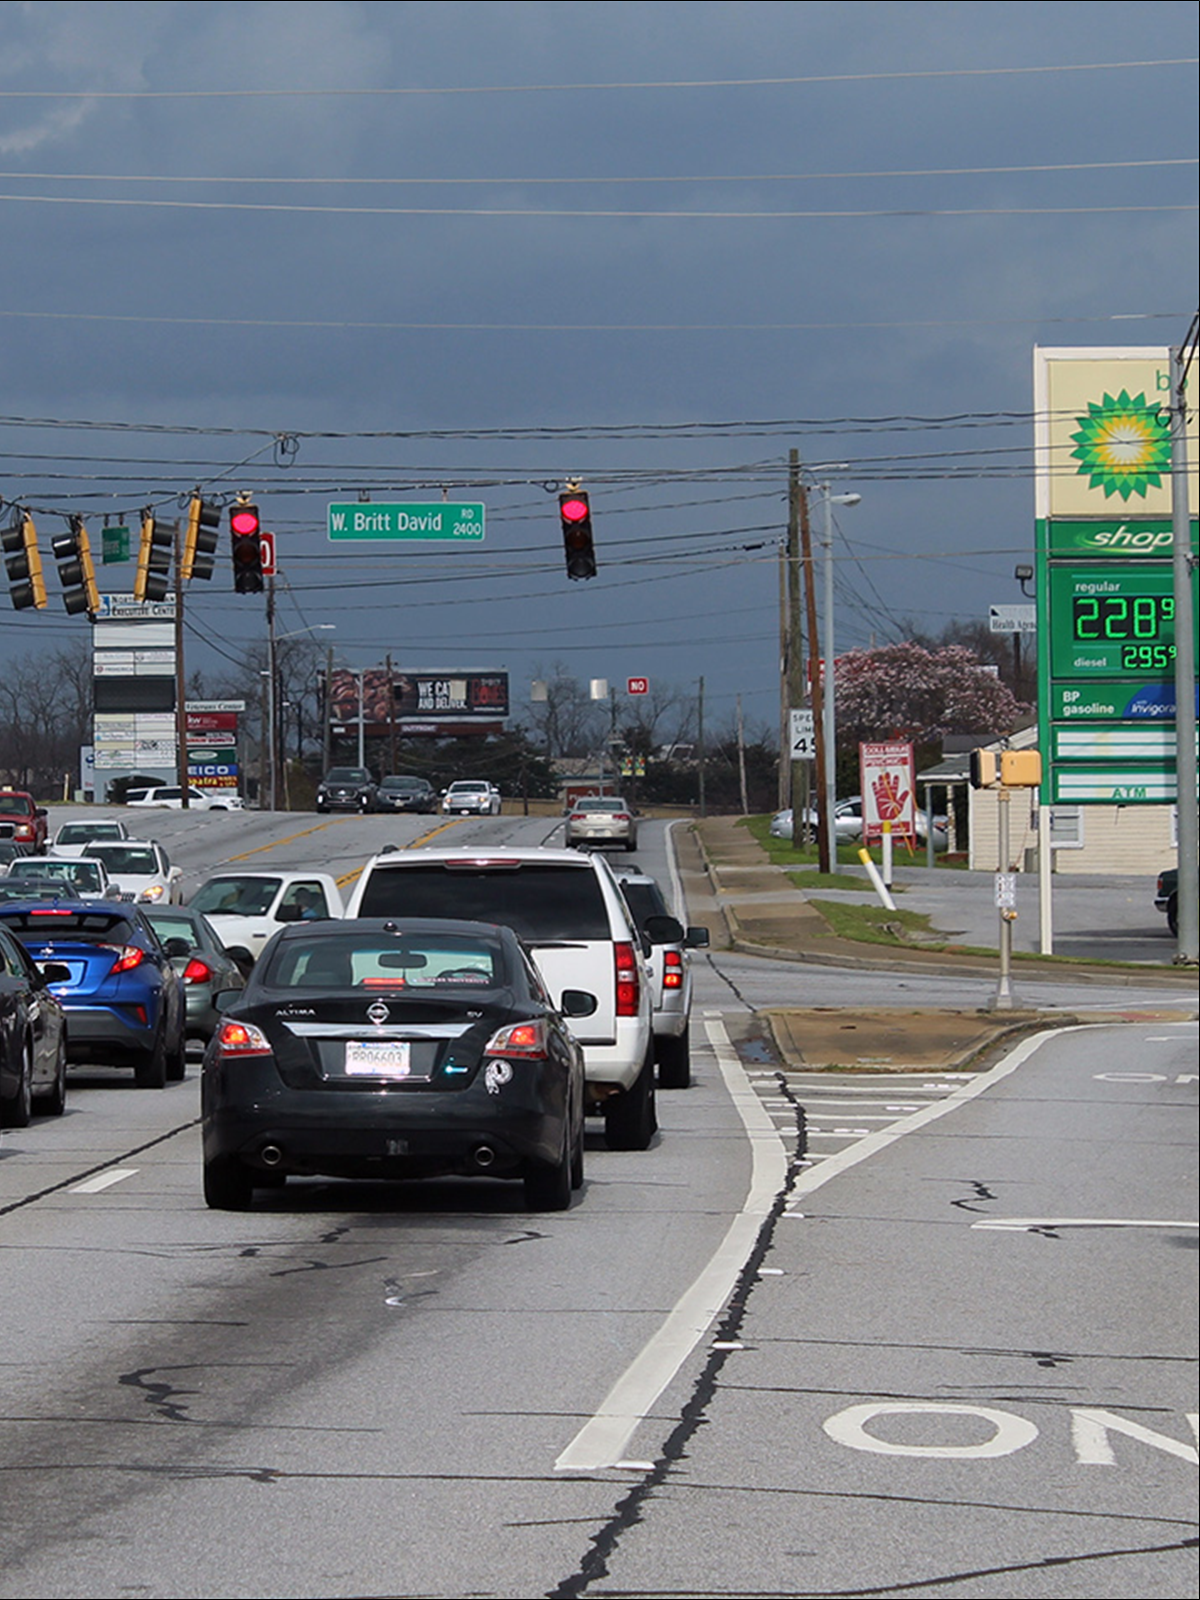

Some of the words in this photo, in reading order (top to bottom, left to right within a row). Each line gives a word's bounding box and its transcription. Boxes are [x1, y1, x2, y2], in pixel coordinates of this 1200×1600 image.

[461, 509, 474, 519] RD
[332, 513, 348, 531] W.
[354, 512, 391, 531] Britt
[398, 513, 442, 531] David
[453, 523, 481, 535] 2400
[1094, 525, 1173, 552] shop
[1075, 582, 1120, 595] regular
[152, 605, 175, 616] CENTE
[1074, 657, 1107, 668] diesel
[418, 682, 433, 696] WE
[630, 681, 644, 691] NO
[1063, 691, 1080, 702] BP
[418, 698, 434, 709] AND
[1063, 703, 1115, 716] gasoline
[1131, 703, 1177, 716] Invigora
[793, 714, 812, 722] SPE
[795, 726, 812, 735] LIM
[187, 765, 230, 776] EICO
[1112, 787, 1147, 798] ATM
[276, 1008, 316, 1017] ALTIMA
[466, 1010, 484, 1018] SV
